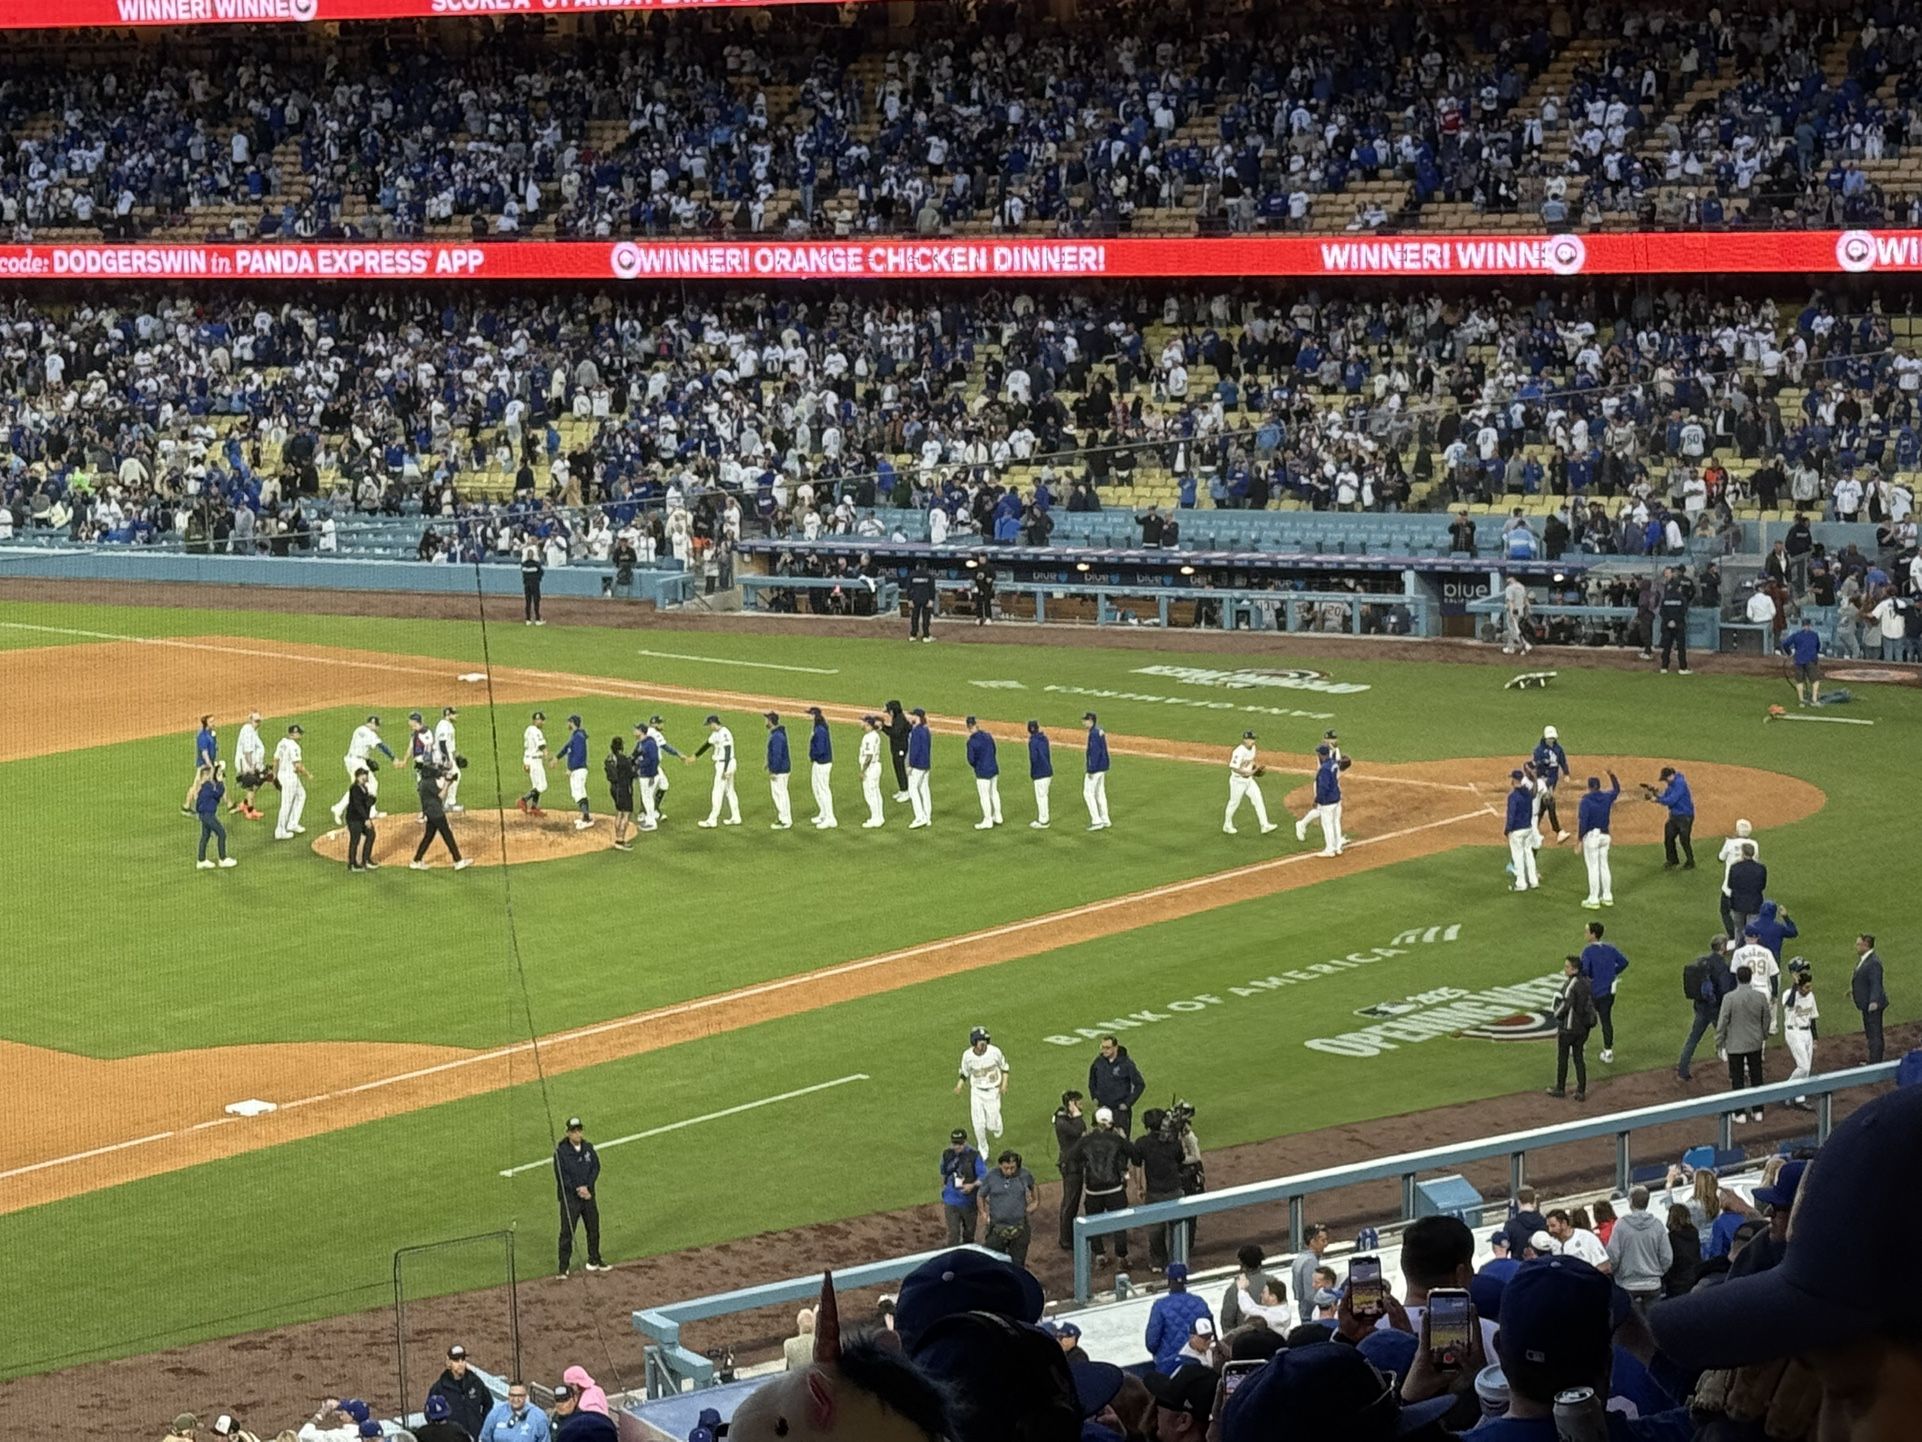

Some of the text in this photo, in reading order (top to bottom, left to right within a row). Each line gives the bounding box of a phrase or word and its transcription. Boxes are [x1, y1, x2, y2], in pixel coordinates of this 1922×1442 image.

[117, 0, 292, 21] WINNER! WINNE
[0, 249, 49, 273] code:
[53, 250, 207, 273] DODGERSWIN
[211, 252, 232, 273] in
[236, 250, 315, 273] PANDA
[435, 250, 484, 273] APP
[640, 246, 1105, 272] WINNER! ORANGE CHICKEN DINNER!
[1321, 240, 1551, 270] WINNER! WINN
[1444, 580, 1488, 598] blue
[1043, 945, 1408, 1046] BANK OF AMERICA
[1304, 1001, 1520, 1057] OPENING
